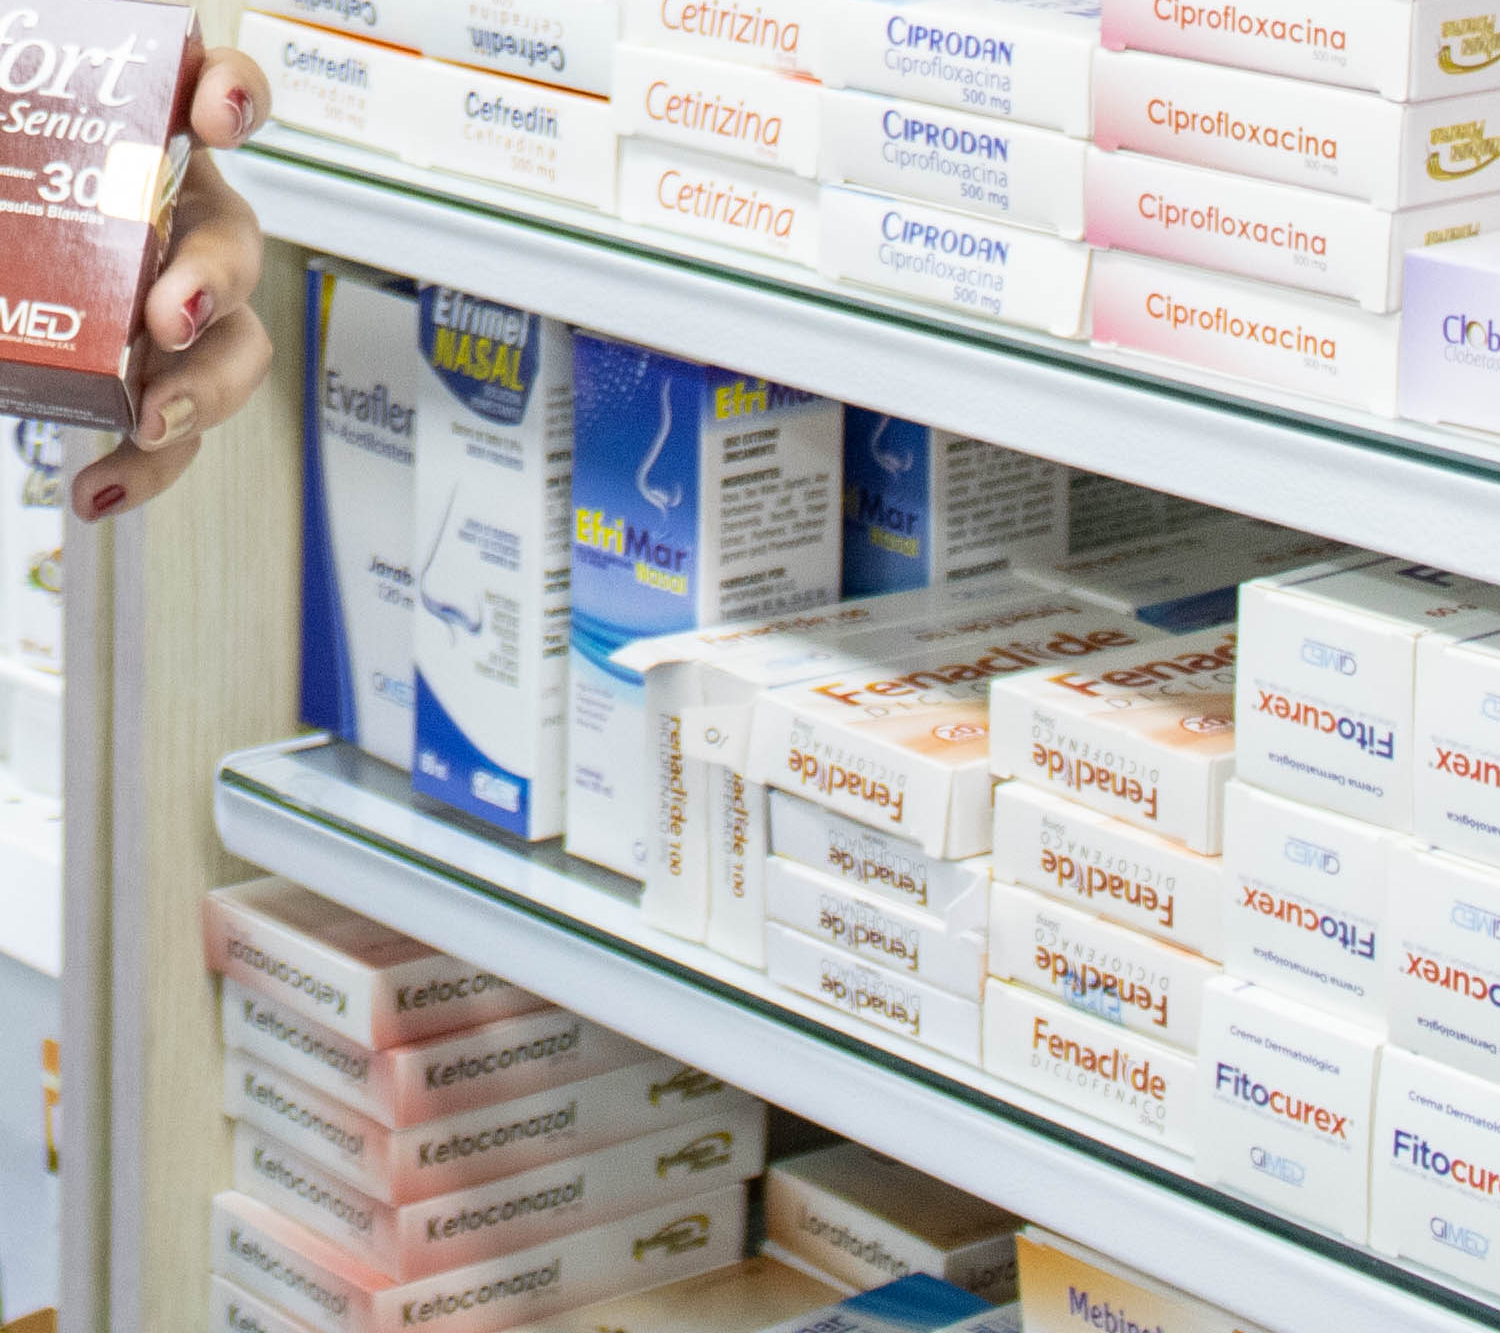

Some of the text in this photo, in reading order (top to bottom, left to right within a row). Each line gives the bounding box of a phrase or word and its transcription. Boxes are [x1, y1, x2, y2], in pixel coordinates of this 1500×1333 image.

[883, 49, 1013, 92] Ciprofloxacina
[2, 101, 125, 147] Senior
[962, 86, 1012, 115] 500 mg
[38, 161, 104, 209] 30
[656, 170, 795, 239] Cetirizina
[1145, 292, 1337, 361] Ciprofloxacina
[433, 331, 524, 393] NASAL
[575, 508, 688, 571] EfriMar
[425, 1025, 582, 1091] Ketoconazol
[1408, 1090, 1445, 1112] Crema
